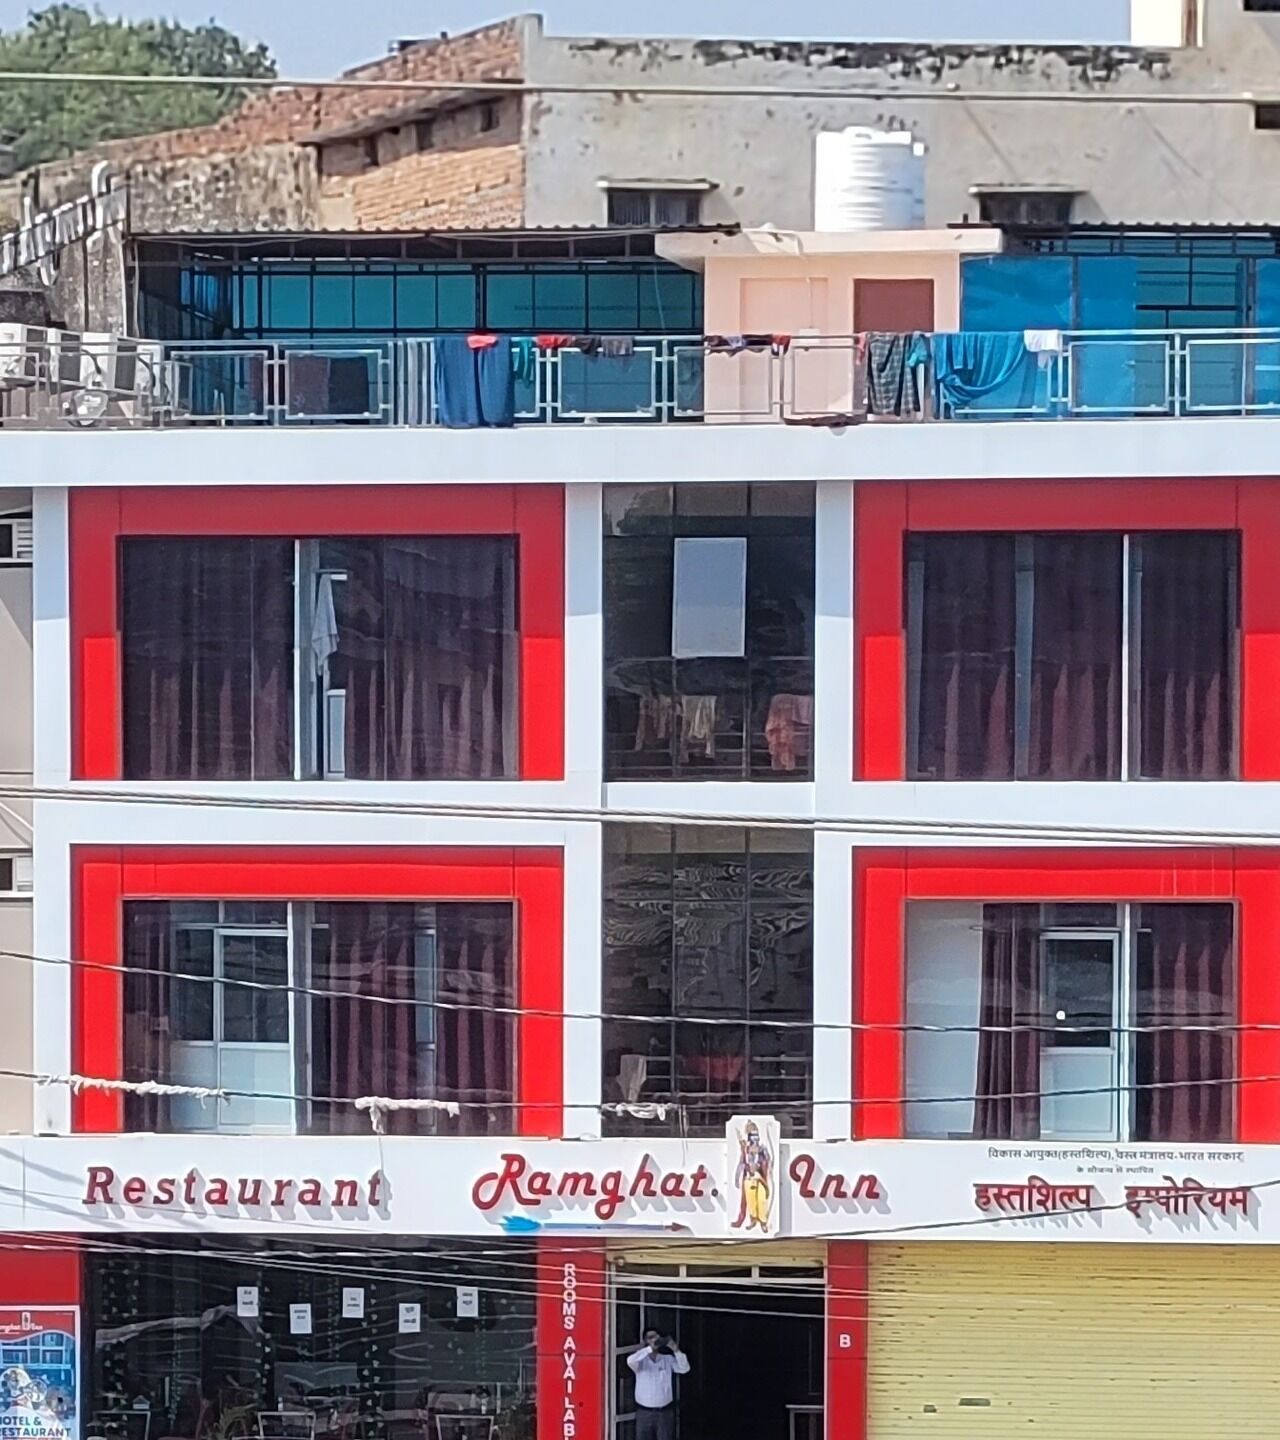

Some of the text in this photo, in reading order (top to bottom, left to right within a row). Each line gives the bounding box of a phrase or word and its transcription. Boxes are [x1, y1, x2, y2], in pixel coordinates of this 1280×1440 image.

[988, 1147, 1022, 1159] विकास
[1207, 1150, 1242, 1161] सरकार
[82, 1166, 381, 1206] Restaurant
[789, 1154, 880, 1200] Inn
[973, 1174, 1095, 1213] हस्तशिल्प
[563, 1263, 576, 1330] ROOMS
[839, 1333, 851, 1348] B
[33, 1416, 42, 1425] &
